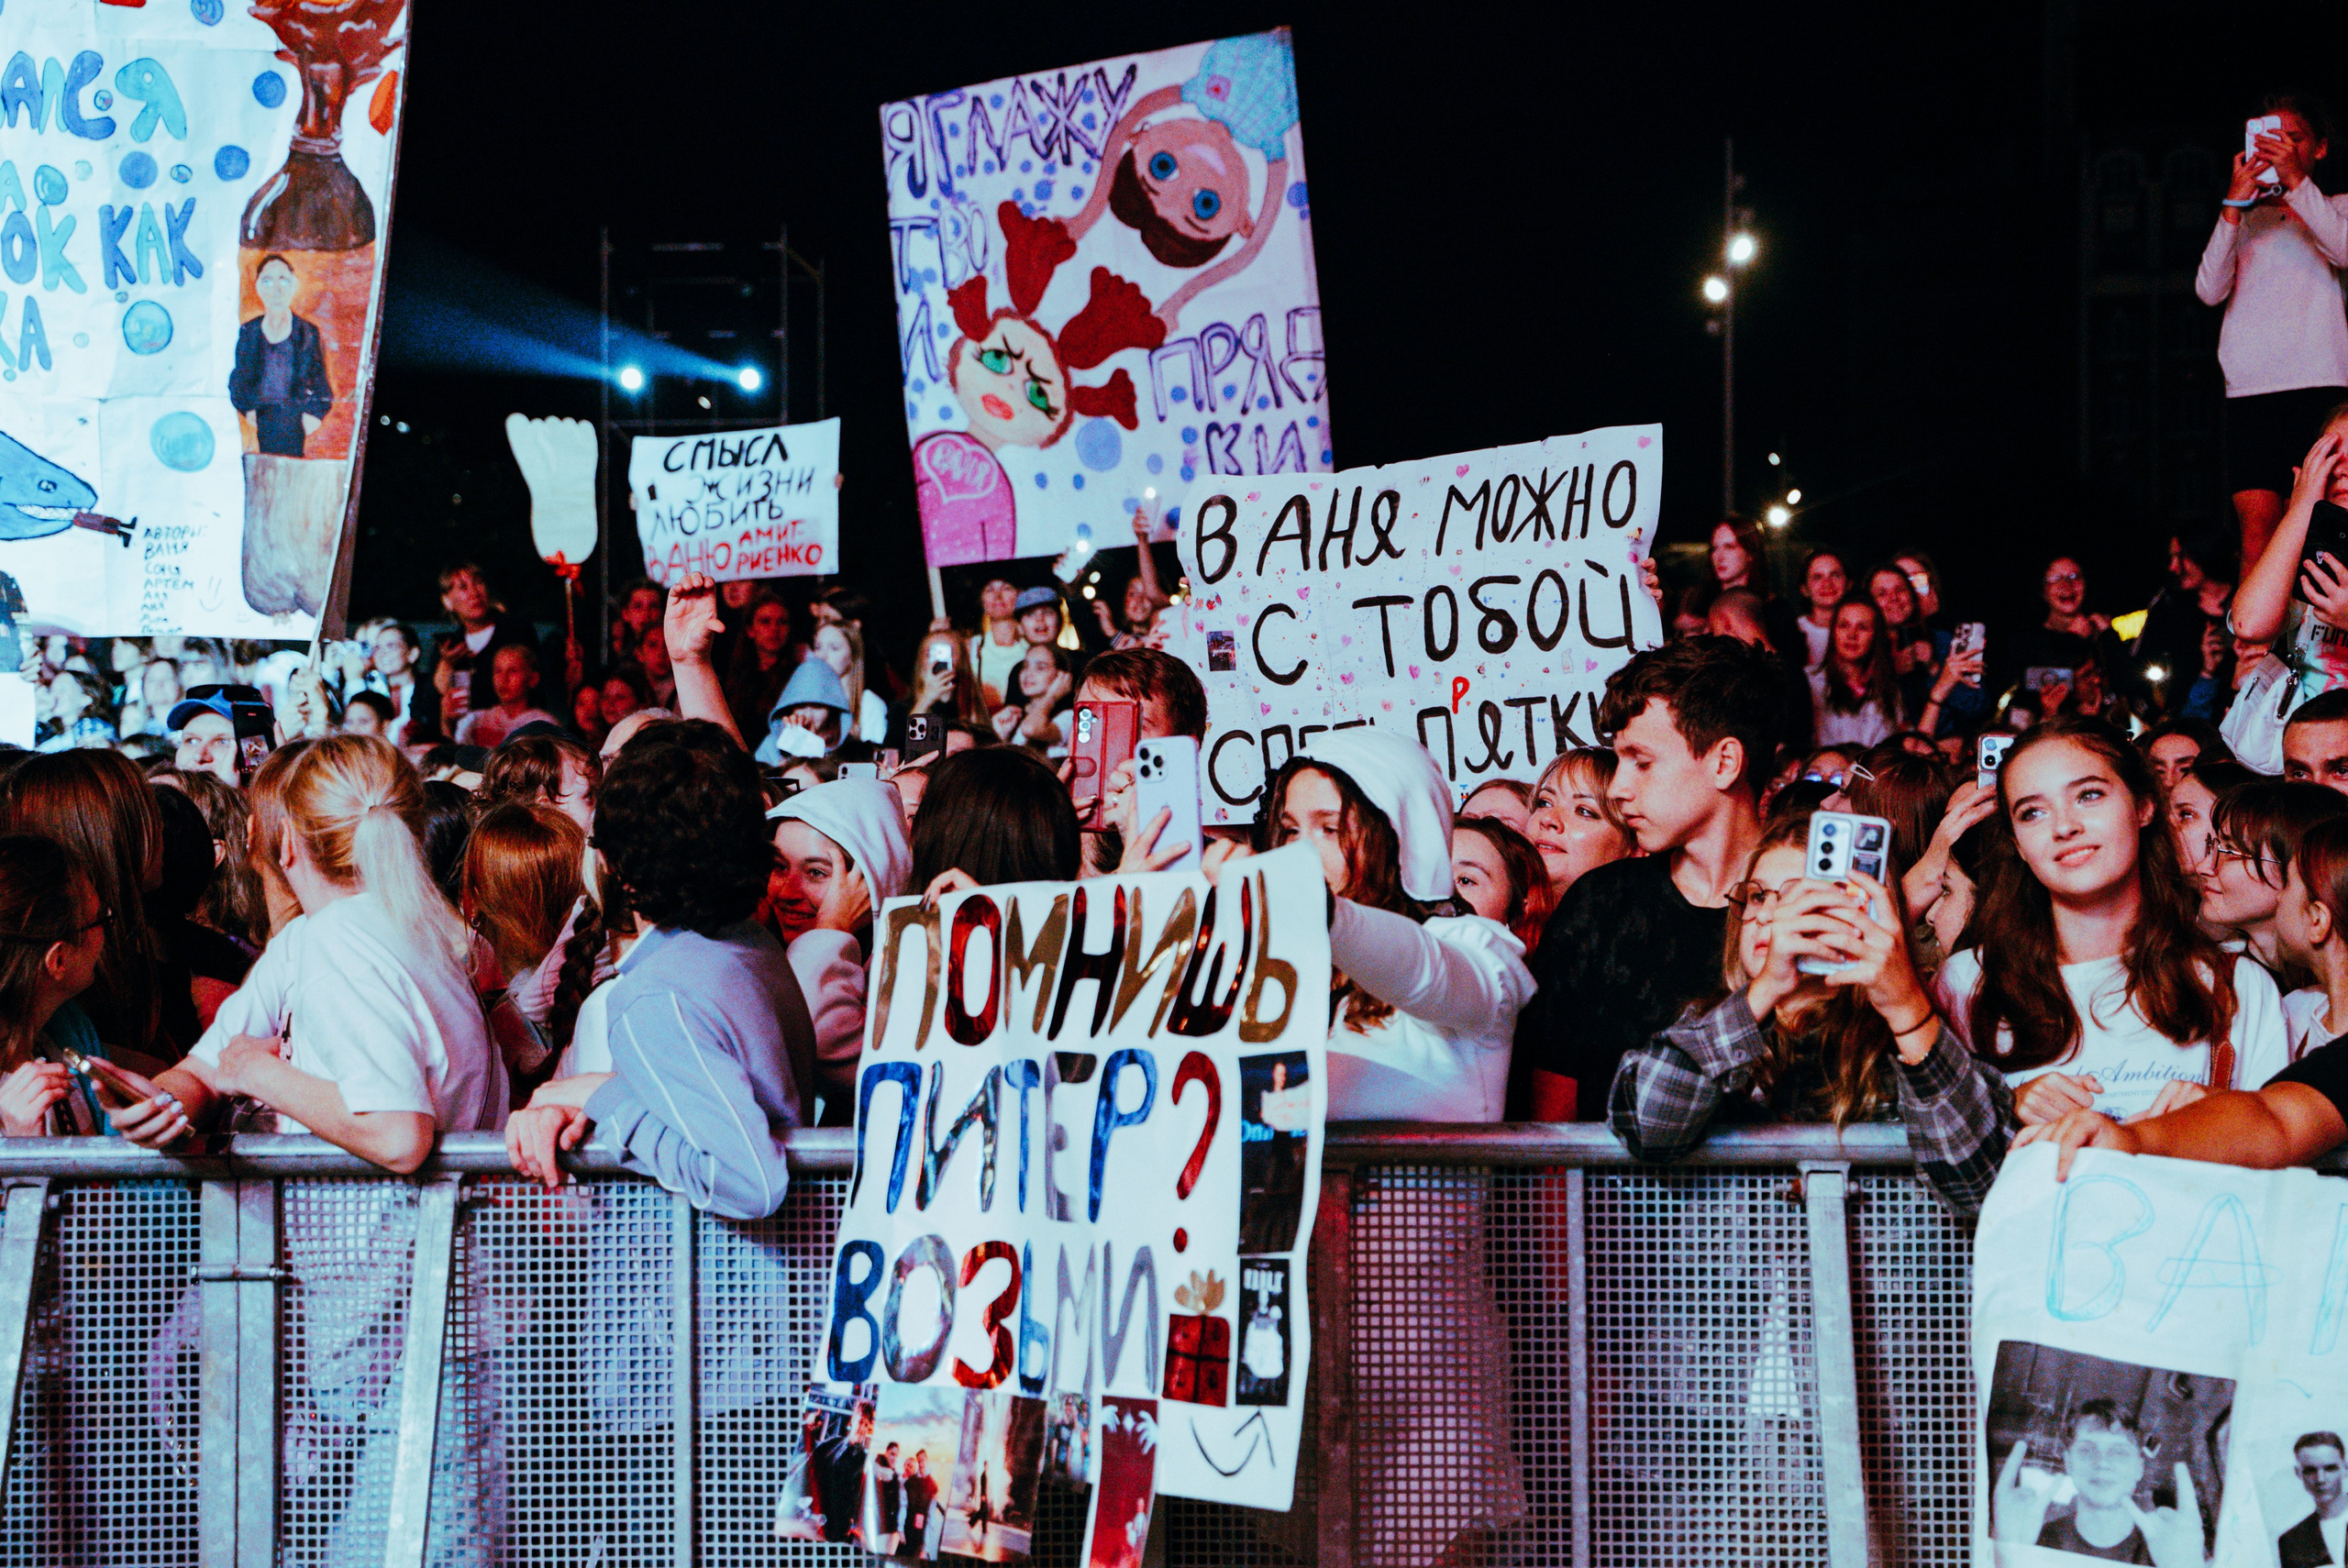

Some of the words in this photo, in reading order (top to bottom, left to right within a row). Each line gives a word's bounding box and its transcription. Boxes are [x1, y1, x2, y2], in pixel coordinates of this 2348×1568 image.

[0, 50, 188, 143] АЛСЯ
[886, 97, 927, 199] Я
[925, 62, 1138, 198] ГЛАЖУ
[98, 197, 205, 290] КАК
[663, 433, 789, 473] СМЫСЛ
[686, 467, 815, 503] ЖИЗНИ
[1204, 420, 1309, 475] КИ
[650, 498, 784, 542] ЛЮБИТЬ
[1434, 458, 1638, 557] МОЖНО
[647, 538, 732, 586] ВАНЮ
[736, 542, 823, 575] РИЕНКО
[1251, 602, 1310, 686] С
[1352, 558, 1638, 679] ТОБОЙ
[871, 868, 1299, 1052] ПОМНИШЬ
[827, 1232, 1160, 1397] ВОЗЬМИ
